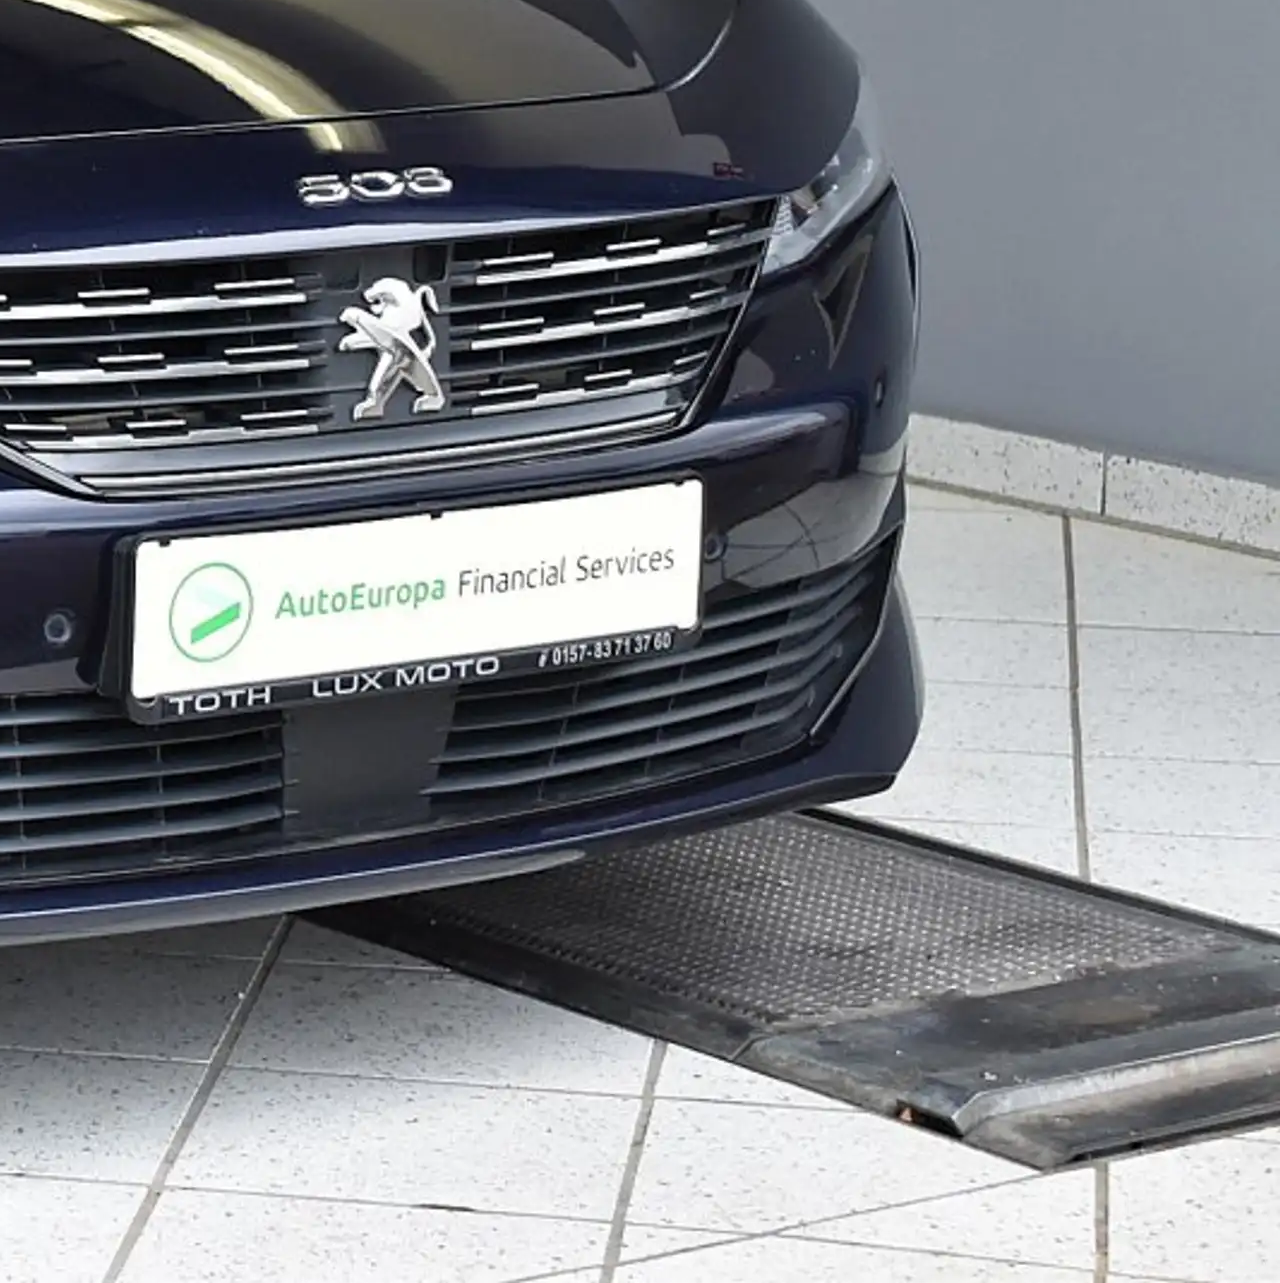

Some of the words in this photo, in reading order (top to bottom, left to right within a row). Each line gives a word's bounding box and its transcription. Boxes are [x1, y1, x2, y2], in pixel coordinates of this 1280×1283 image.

[298, 167, 453, 205] 508
[274, 575, 447, 619] AutoEuropa
[458, 556, 567, 598] Financial
[576, 547, 675, 582] Services
[169, 685, 271, 716] TOTH
[312, 671, 383, 697] LUX
[395, 655, 500, 688] MOTO
